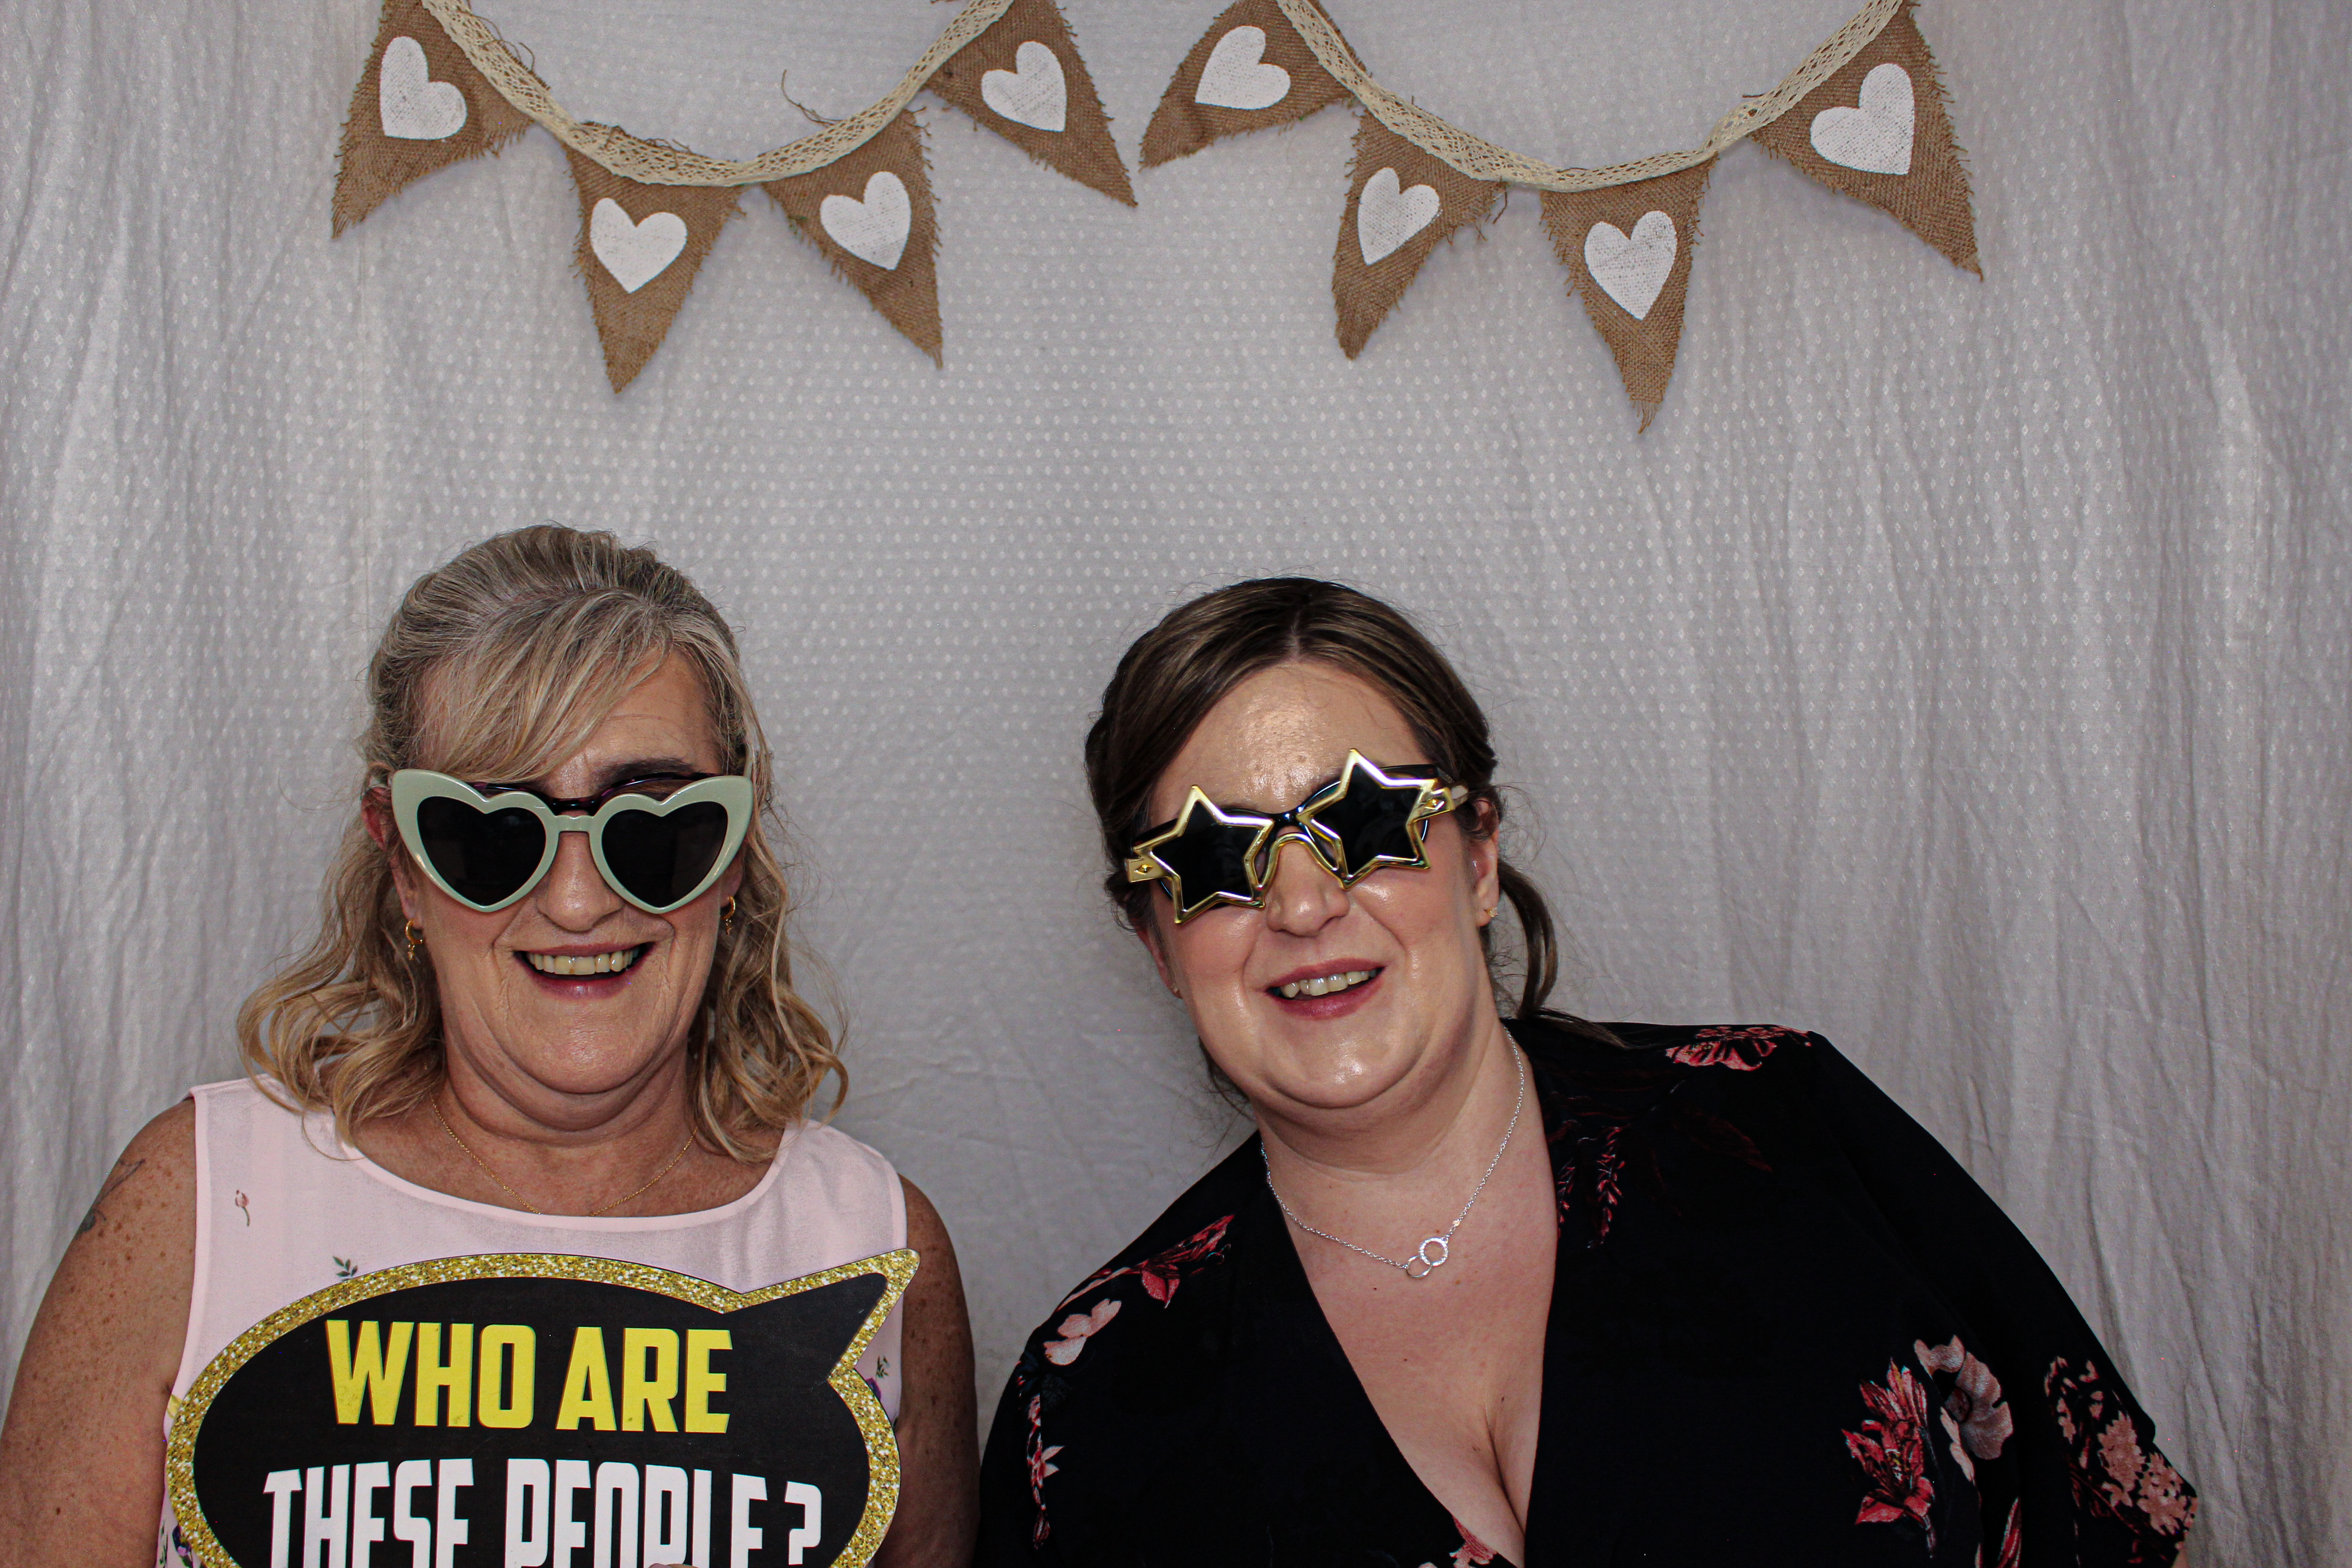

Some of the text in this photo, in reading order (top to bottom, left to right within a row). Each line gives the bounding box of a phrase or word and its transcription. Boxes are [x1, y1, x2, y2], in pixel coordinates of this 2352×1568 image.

[325, 1319, 733, 1434] WHO ARE
[263, 1458, 474, 1568] THESE
